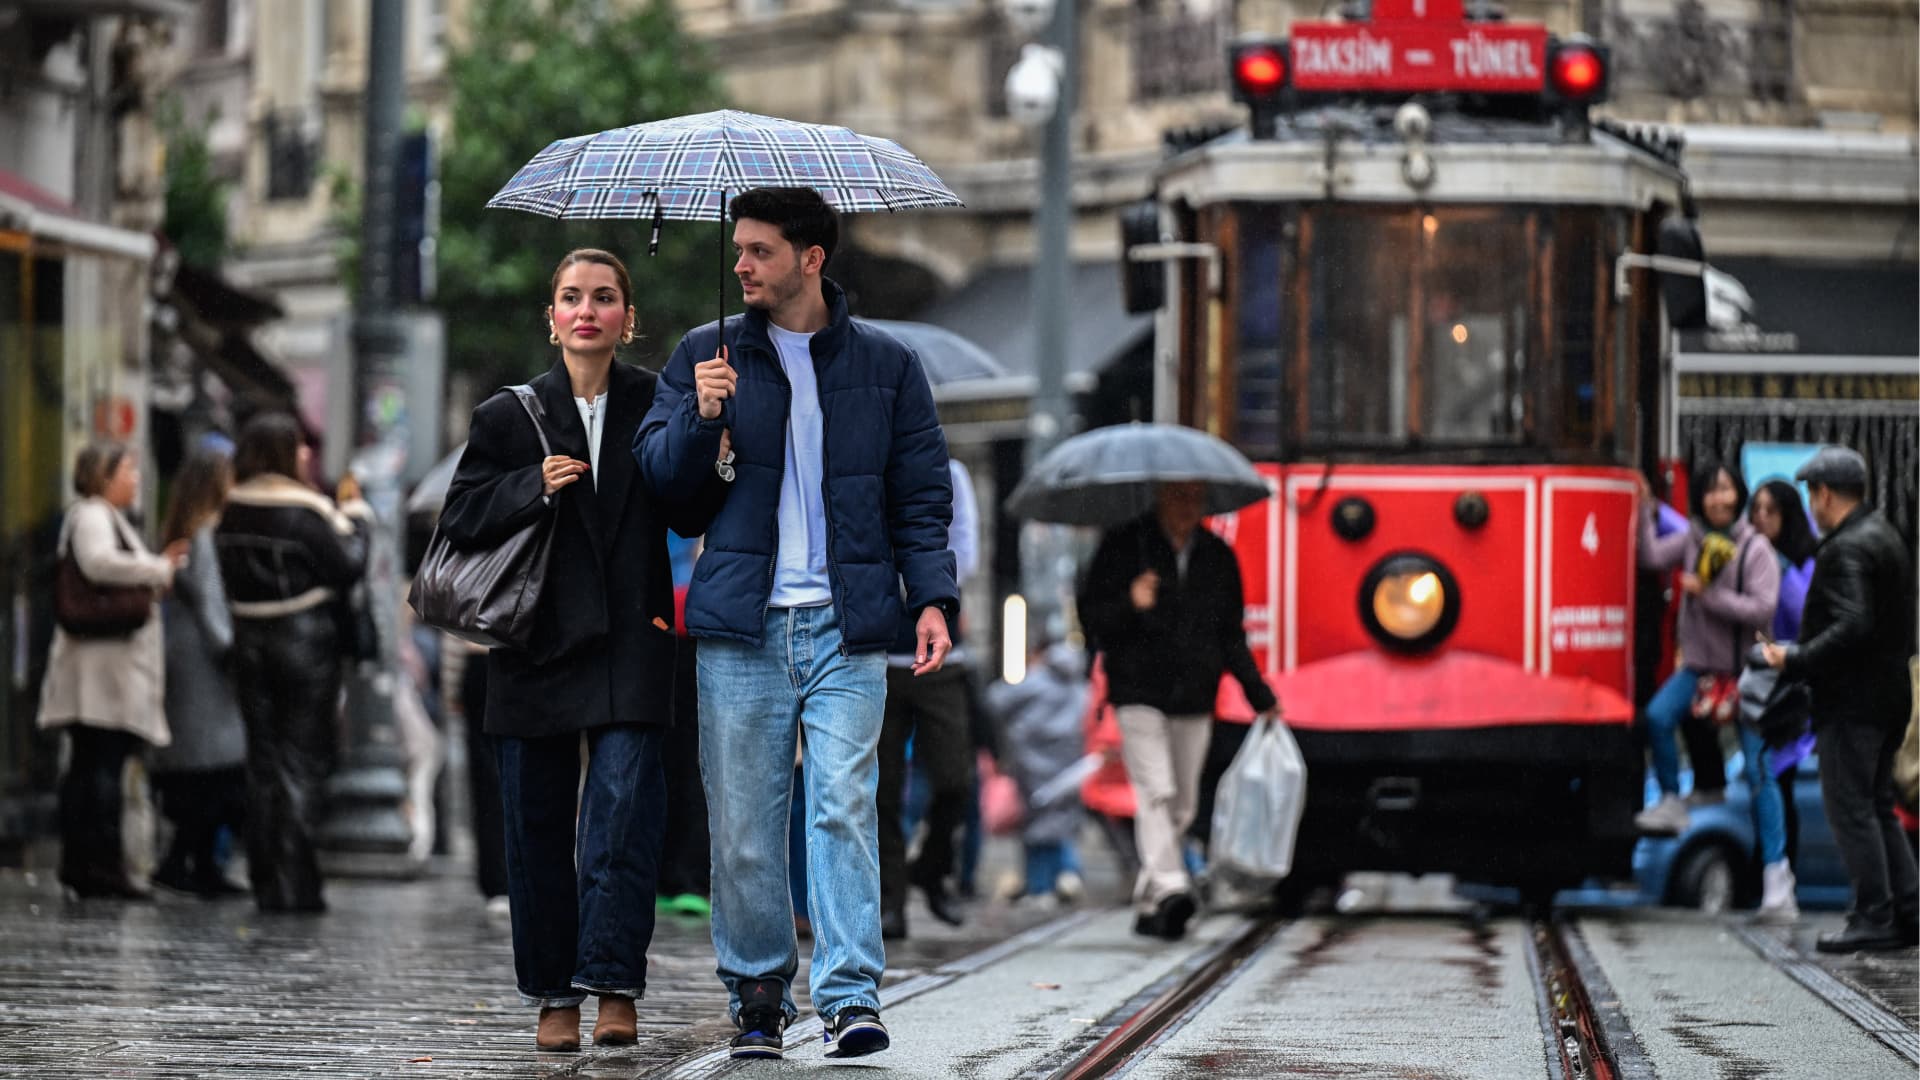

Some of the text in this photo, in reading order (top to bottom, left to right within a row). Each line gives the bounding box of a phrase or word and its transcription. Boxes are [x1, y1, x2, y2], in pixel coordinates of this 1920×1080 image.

[1295, 29, 1393, 76] TAKSİM
[1450, 31, 1539, 78] TÜNEL
[1581, 512, 1599, 556] 4
